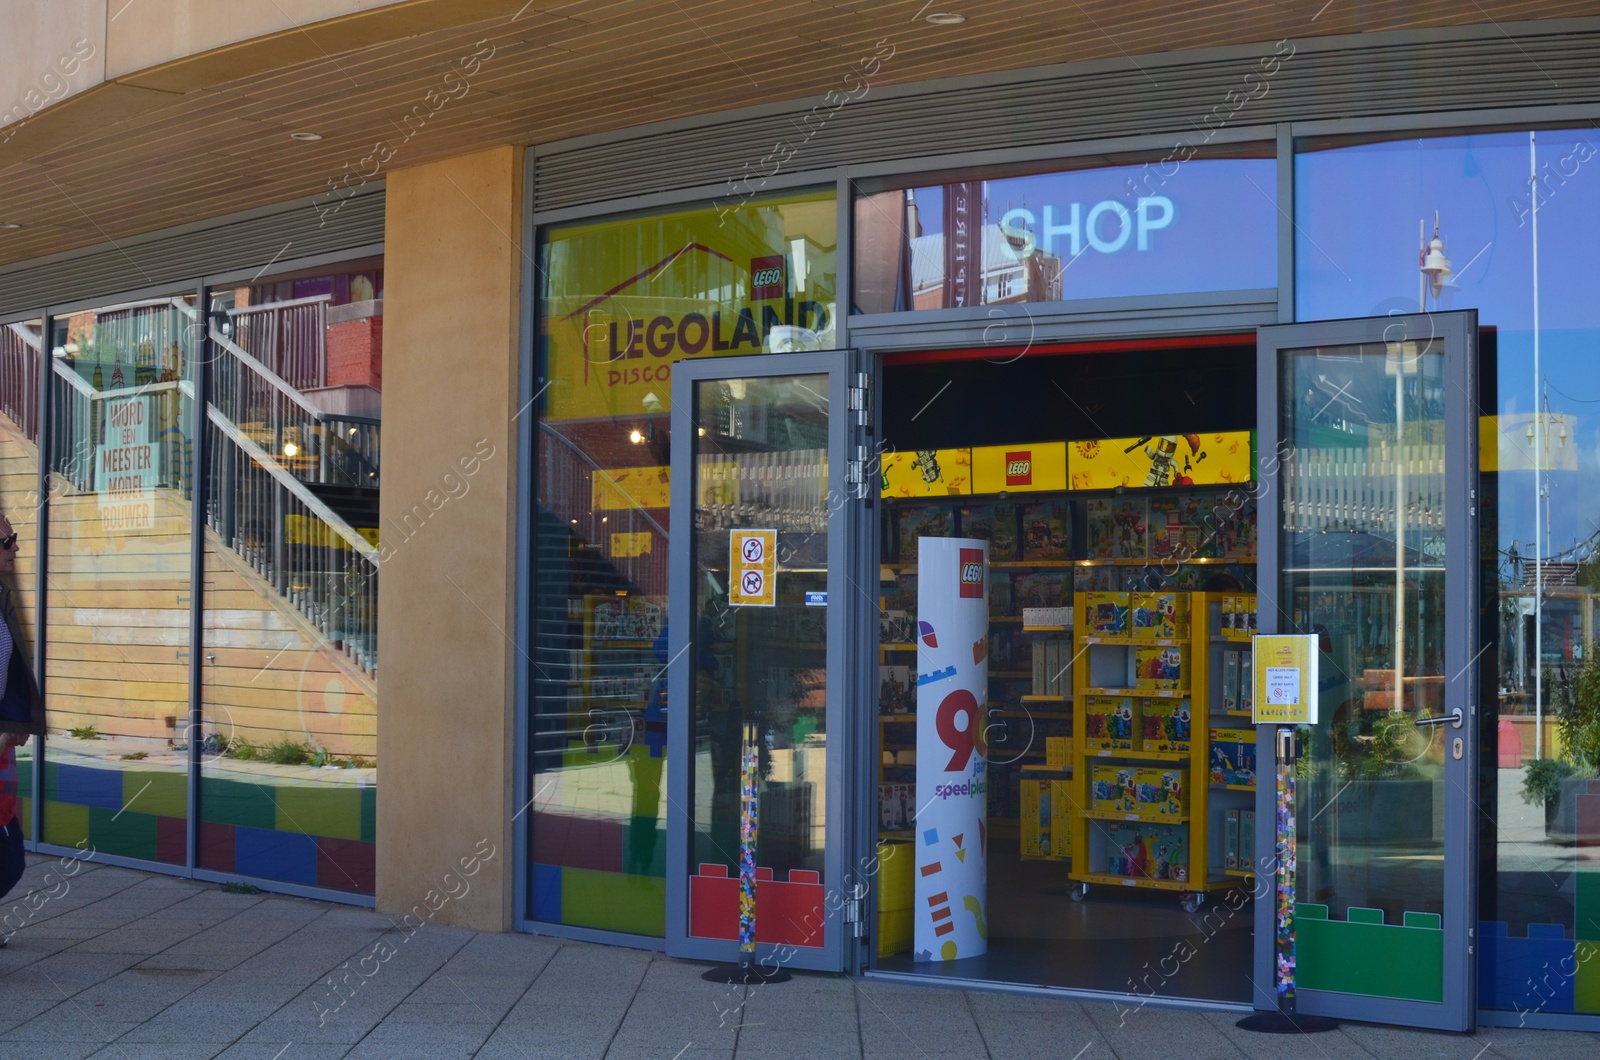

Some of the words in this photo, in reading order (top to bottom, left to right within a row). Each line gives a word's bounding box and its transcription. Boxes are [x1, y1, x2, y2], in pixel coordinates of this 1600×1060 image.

[1001, 196, 1176, 260] SHOP
[752, 267, 782, 288] LEGO
[609, 299, 827, 361] LEGOLAND
[110, 401, 144, 428] WORD
[122, 428, 136, 445] EEN
[103, 445, 151, 473] MEESTER
[1006, 459, 1031, 476] LEGO
[108, 474, 145, 501] MODEL
[103, 503, 150, 529] BOUWER
[961, 563, 983, 584] LEGO
[1119, 823, 1142, 832] CLASSIC
